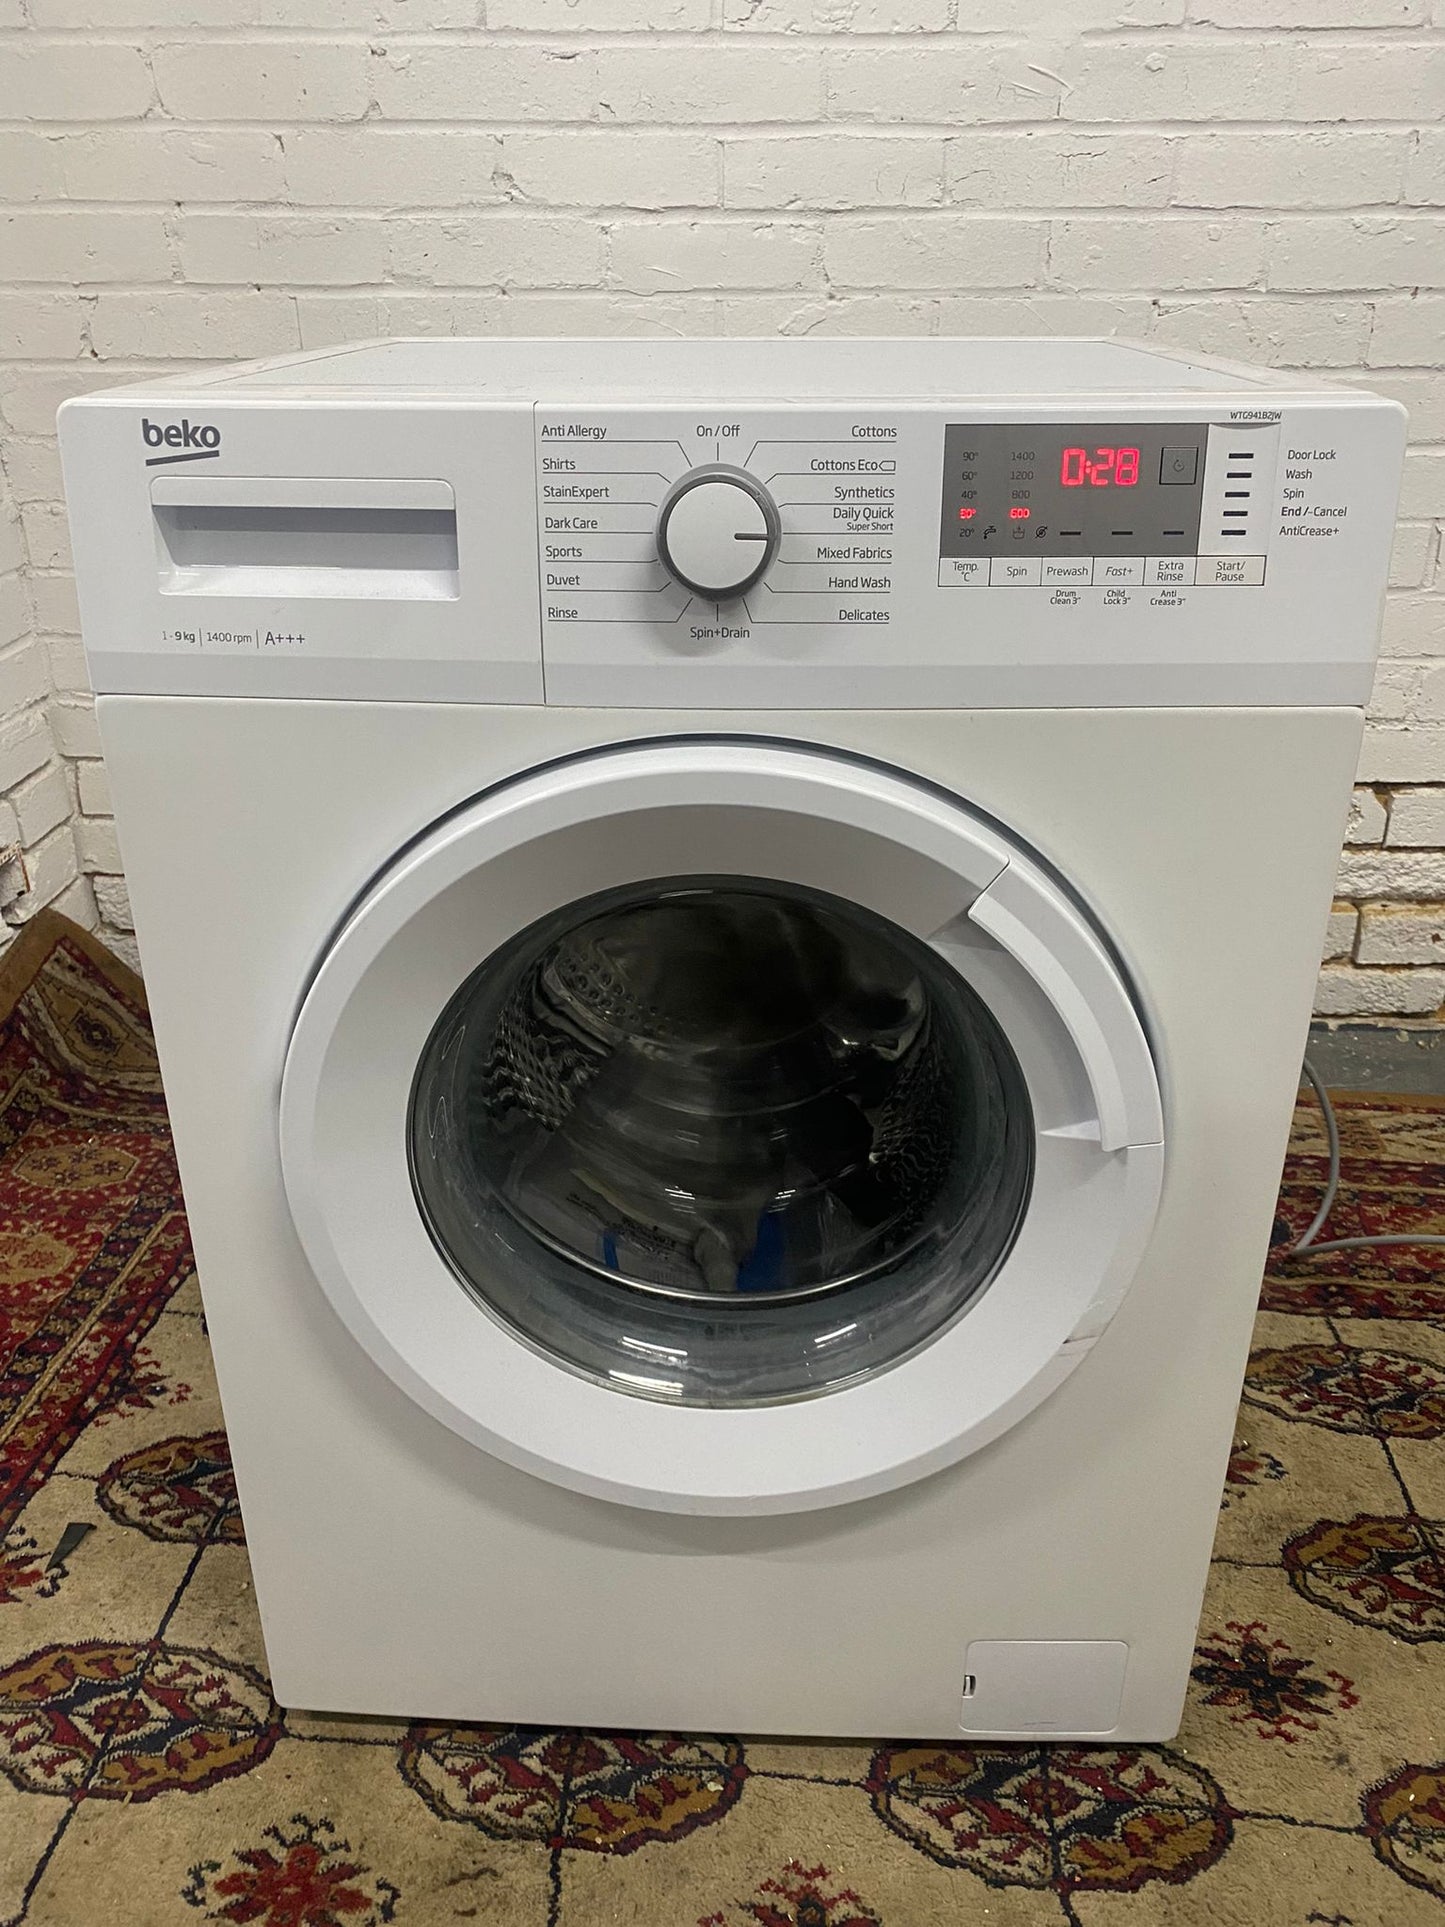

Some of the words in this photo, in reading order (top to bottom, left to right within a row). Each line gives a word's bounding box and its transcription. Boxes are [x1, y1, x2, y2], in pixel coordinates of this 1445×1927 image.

[142, 419, 220, 448] beko
[541, 425, 565, 437] Anti
[567, 425, 607, 439] Allergy
[696, 425, 713, 437] On
[721, 425, 741, 437] Off
[851, 425, 897, 438] Cottons
[1011, 451, 1035, 461] 1400
[1287, 450, 1312, 460] Door
[1313, 450, 1336, 460] Lock
[542, 458, 576, 470] Shirts
[810, 459, 855, 471] Cottons
[857, 460, 878, 471] Eco
[1060, 447, 1141, 486] 0:28
[1010, 470, 1034, 480] 1200
[1285, 469, 1313, 479] Wash
[543, 486, 610, 500] StainExpert
[834, 486, 895, 501] Synthetics
[1011, 490, 1031, 500] 800
[1283, 488, 1305, 500] Spin
[833, 508, 861, 521] Daily
[862, 508, 894, 520] Quick
[1281, 506, 1302, 517] End
[545, 517, 571, 529] Dark
[572, 518, 598, 529] Care
[846, 522, 870, 532] Super
[871, 521, 893, 531] Short
[1279, 525, 1340, 537] AntiCrease+
[545, 546, 582, 560] Sports
[817, 547, 851, 559] Mixed
[852, 547, 893, 559] Fabrics
[953, 561, 979, 572] Temp.
[1158, 560, 1184, 571] Extra
[1217, 561, 1246, 572] Start/
[1006, 566, 1028, 577] Spin
[1046, 566, 1089, 577] Prewash
[1105, 567, 1134, 577] Fast+
[1156, 572, 1184, 582] Rinse
[1215, 572, 1245, 582] Pause
[547, 574, 580, 586] Duvet
[828, 577, 859, 589] Hand
[860, 577, 891, 588] Wash
[1055, 590, 1077, 598] Drum
[1106, 590, 1126, 598] Child
[1160, 590, 1177, 598] Anti
[1050, 597, 1071, 605] Clean
[1103, 597, 1121, 605] Lock
[548, 607, 578, 618] Rinse
[838, 609, 890, 621] Delicates
[206, 632, 232, 642] 1400
[233, 633, 252, 644] rpm
[264, 631, 306, 646] A+++
[690, 627, 750, 640] Spin+Drain
